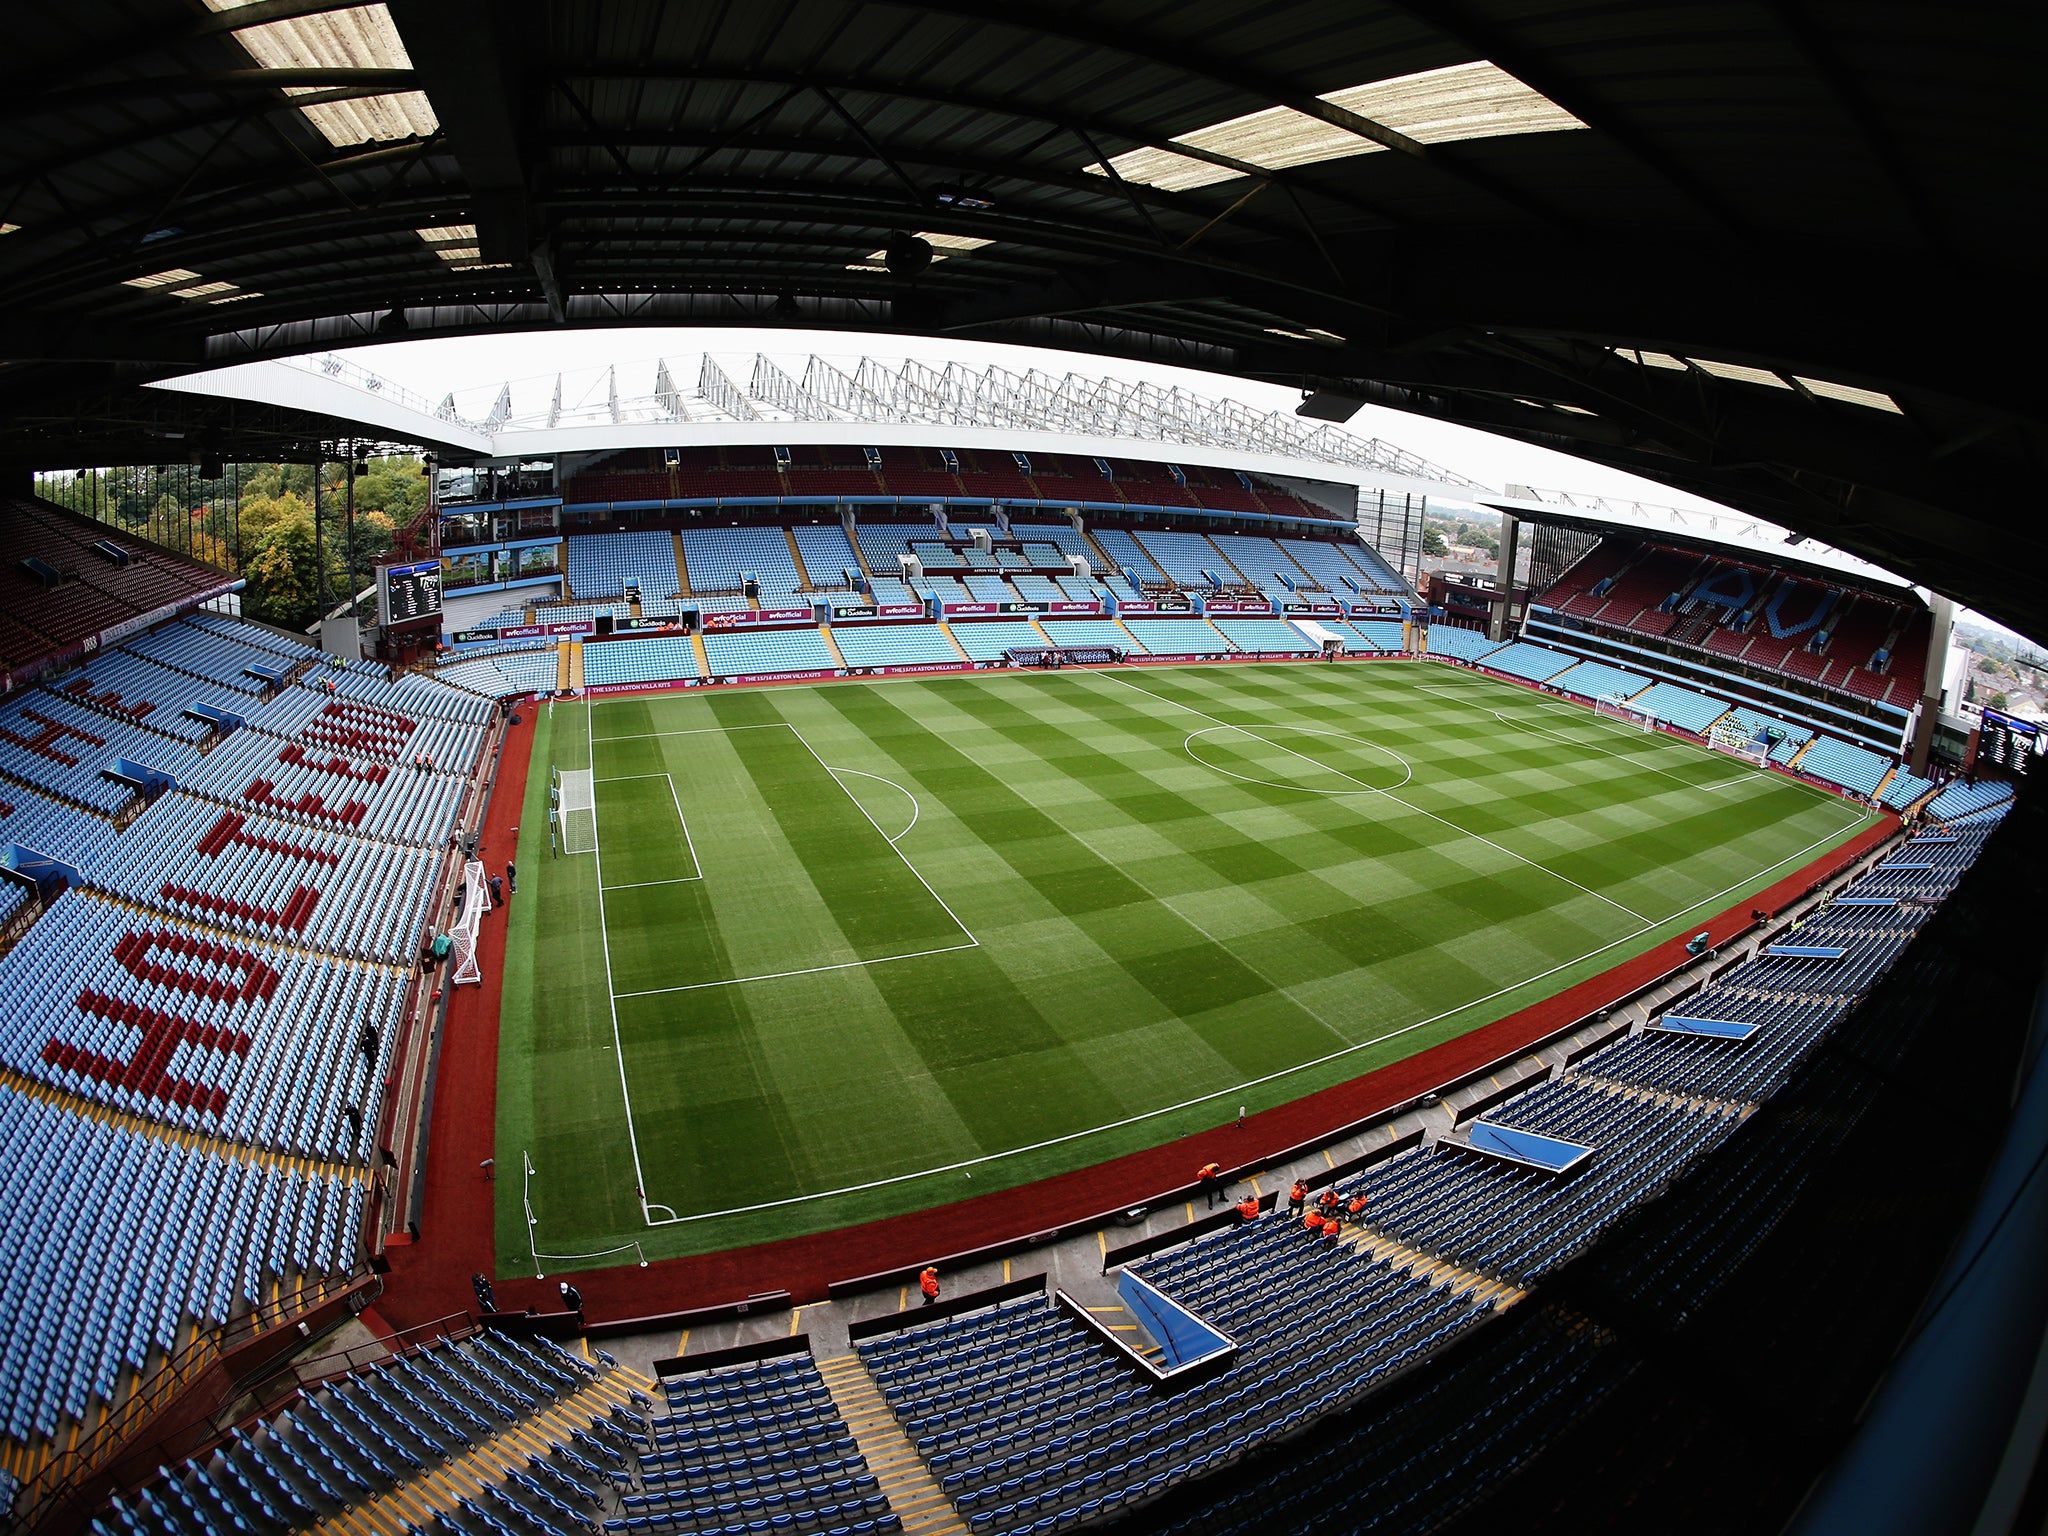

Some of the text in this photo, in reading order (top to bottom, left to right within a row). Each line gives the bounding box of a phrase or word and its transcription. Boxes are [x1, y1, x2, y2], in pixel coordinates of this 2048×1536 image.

[506, 627, 540, 637] avfcofficial
[553, 624, 587, 633] avfcofficial
[621, 684, 641, 692] ASTON
